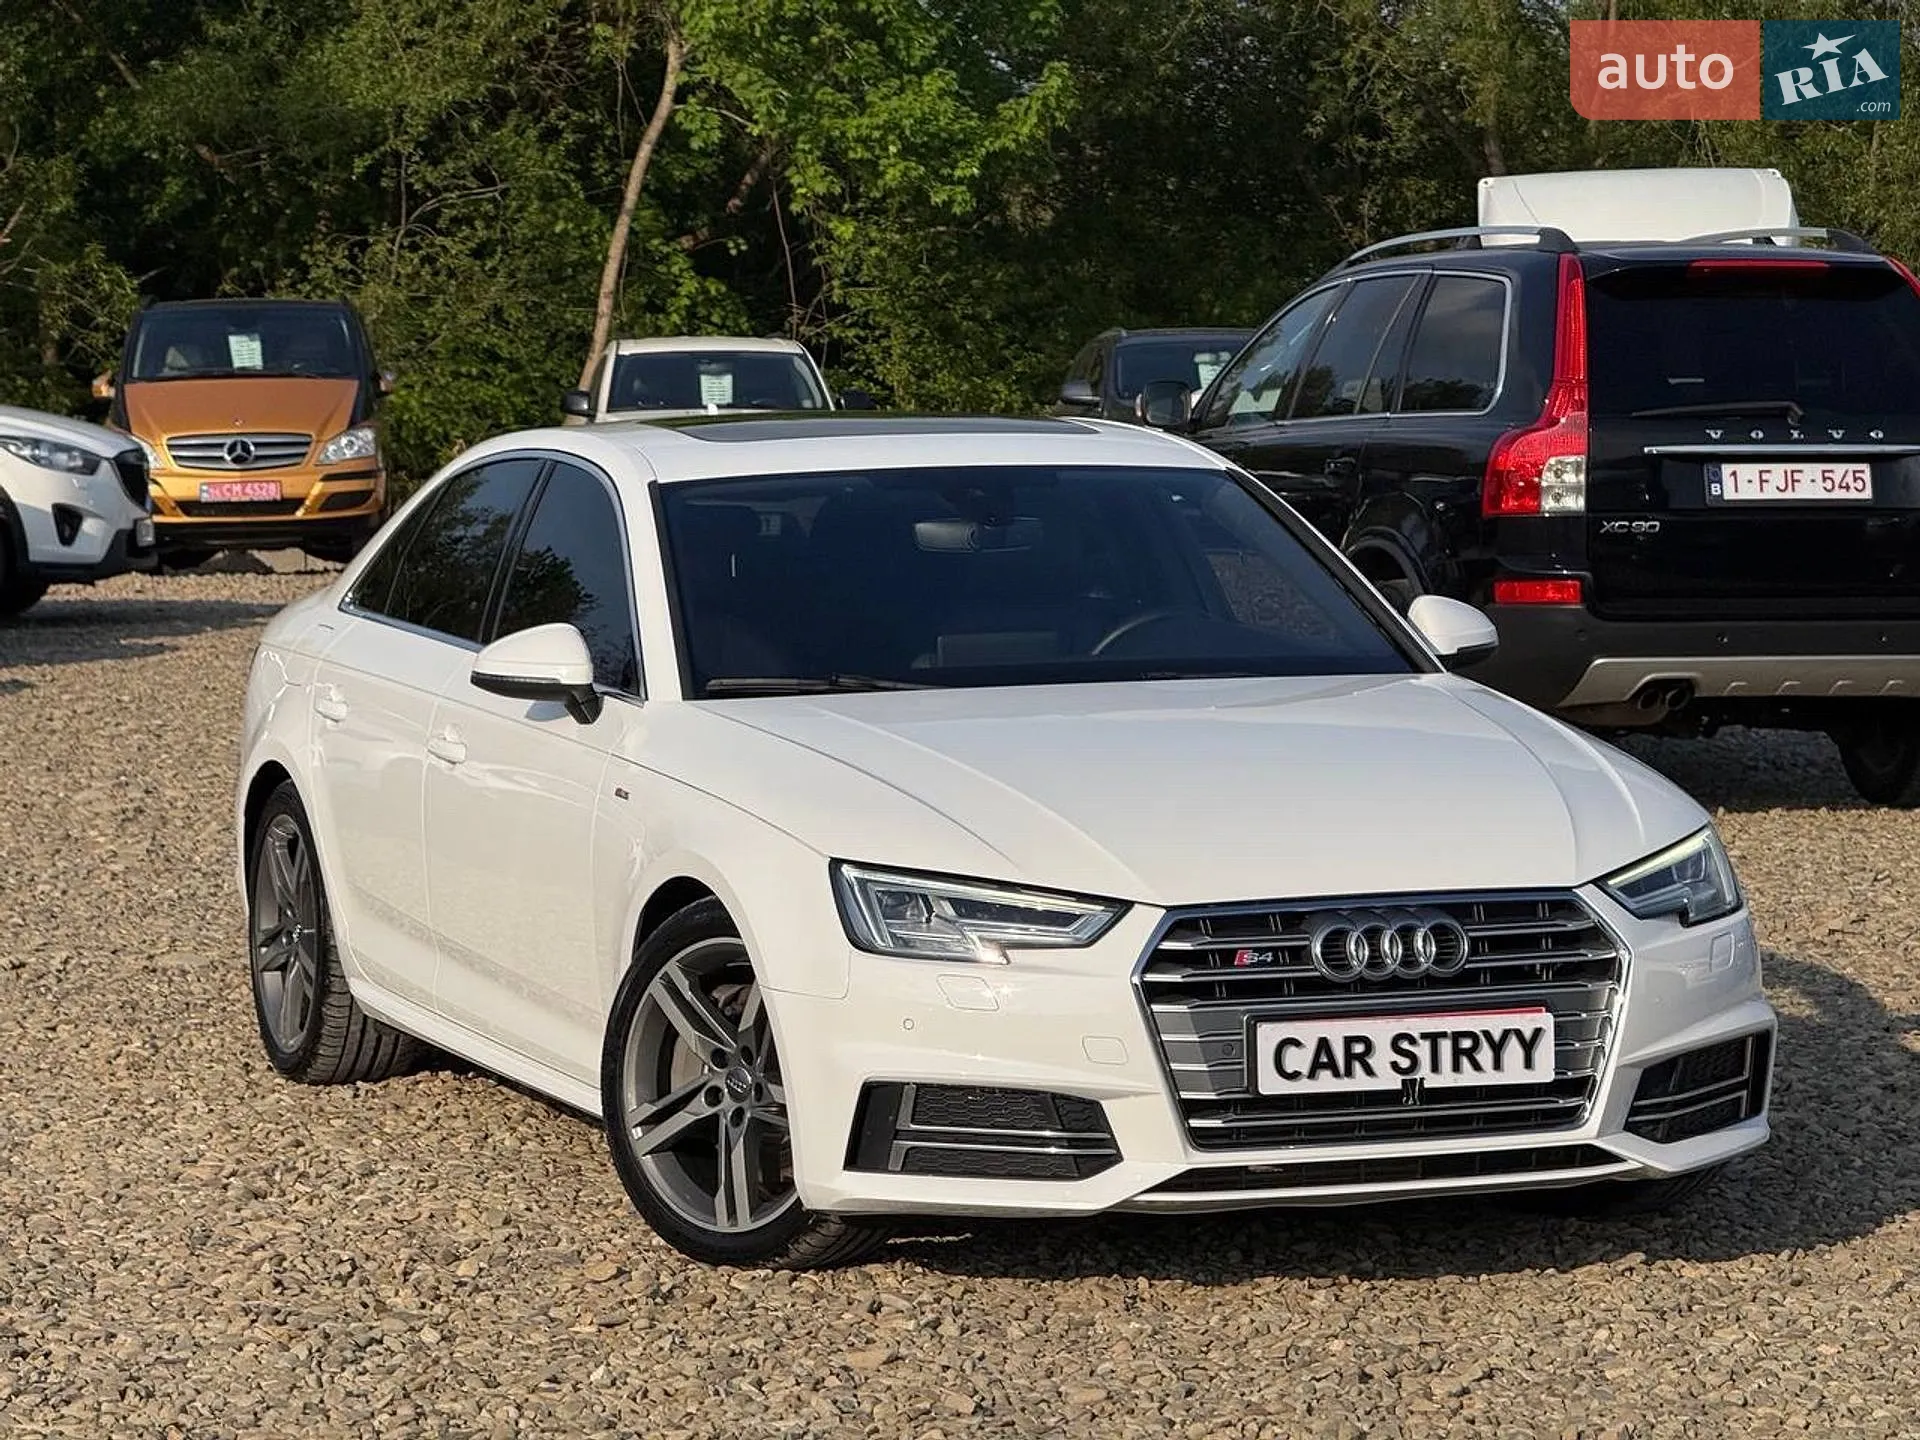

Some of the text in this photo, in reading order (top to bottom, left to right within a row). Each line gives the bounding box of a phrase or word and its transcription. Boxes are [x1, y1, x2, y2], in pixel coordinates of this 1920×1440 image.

[1711, 484, 1721, 495] B
[1600, 520, 1660, 533] XC90
[1273, 1027, 1546, 1081] CAR STRYY
